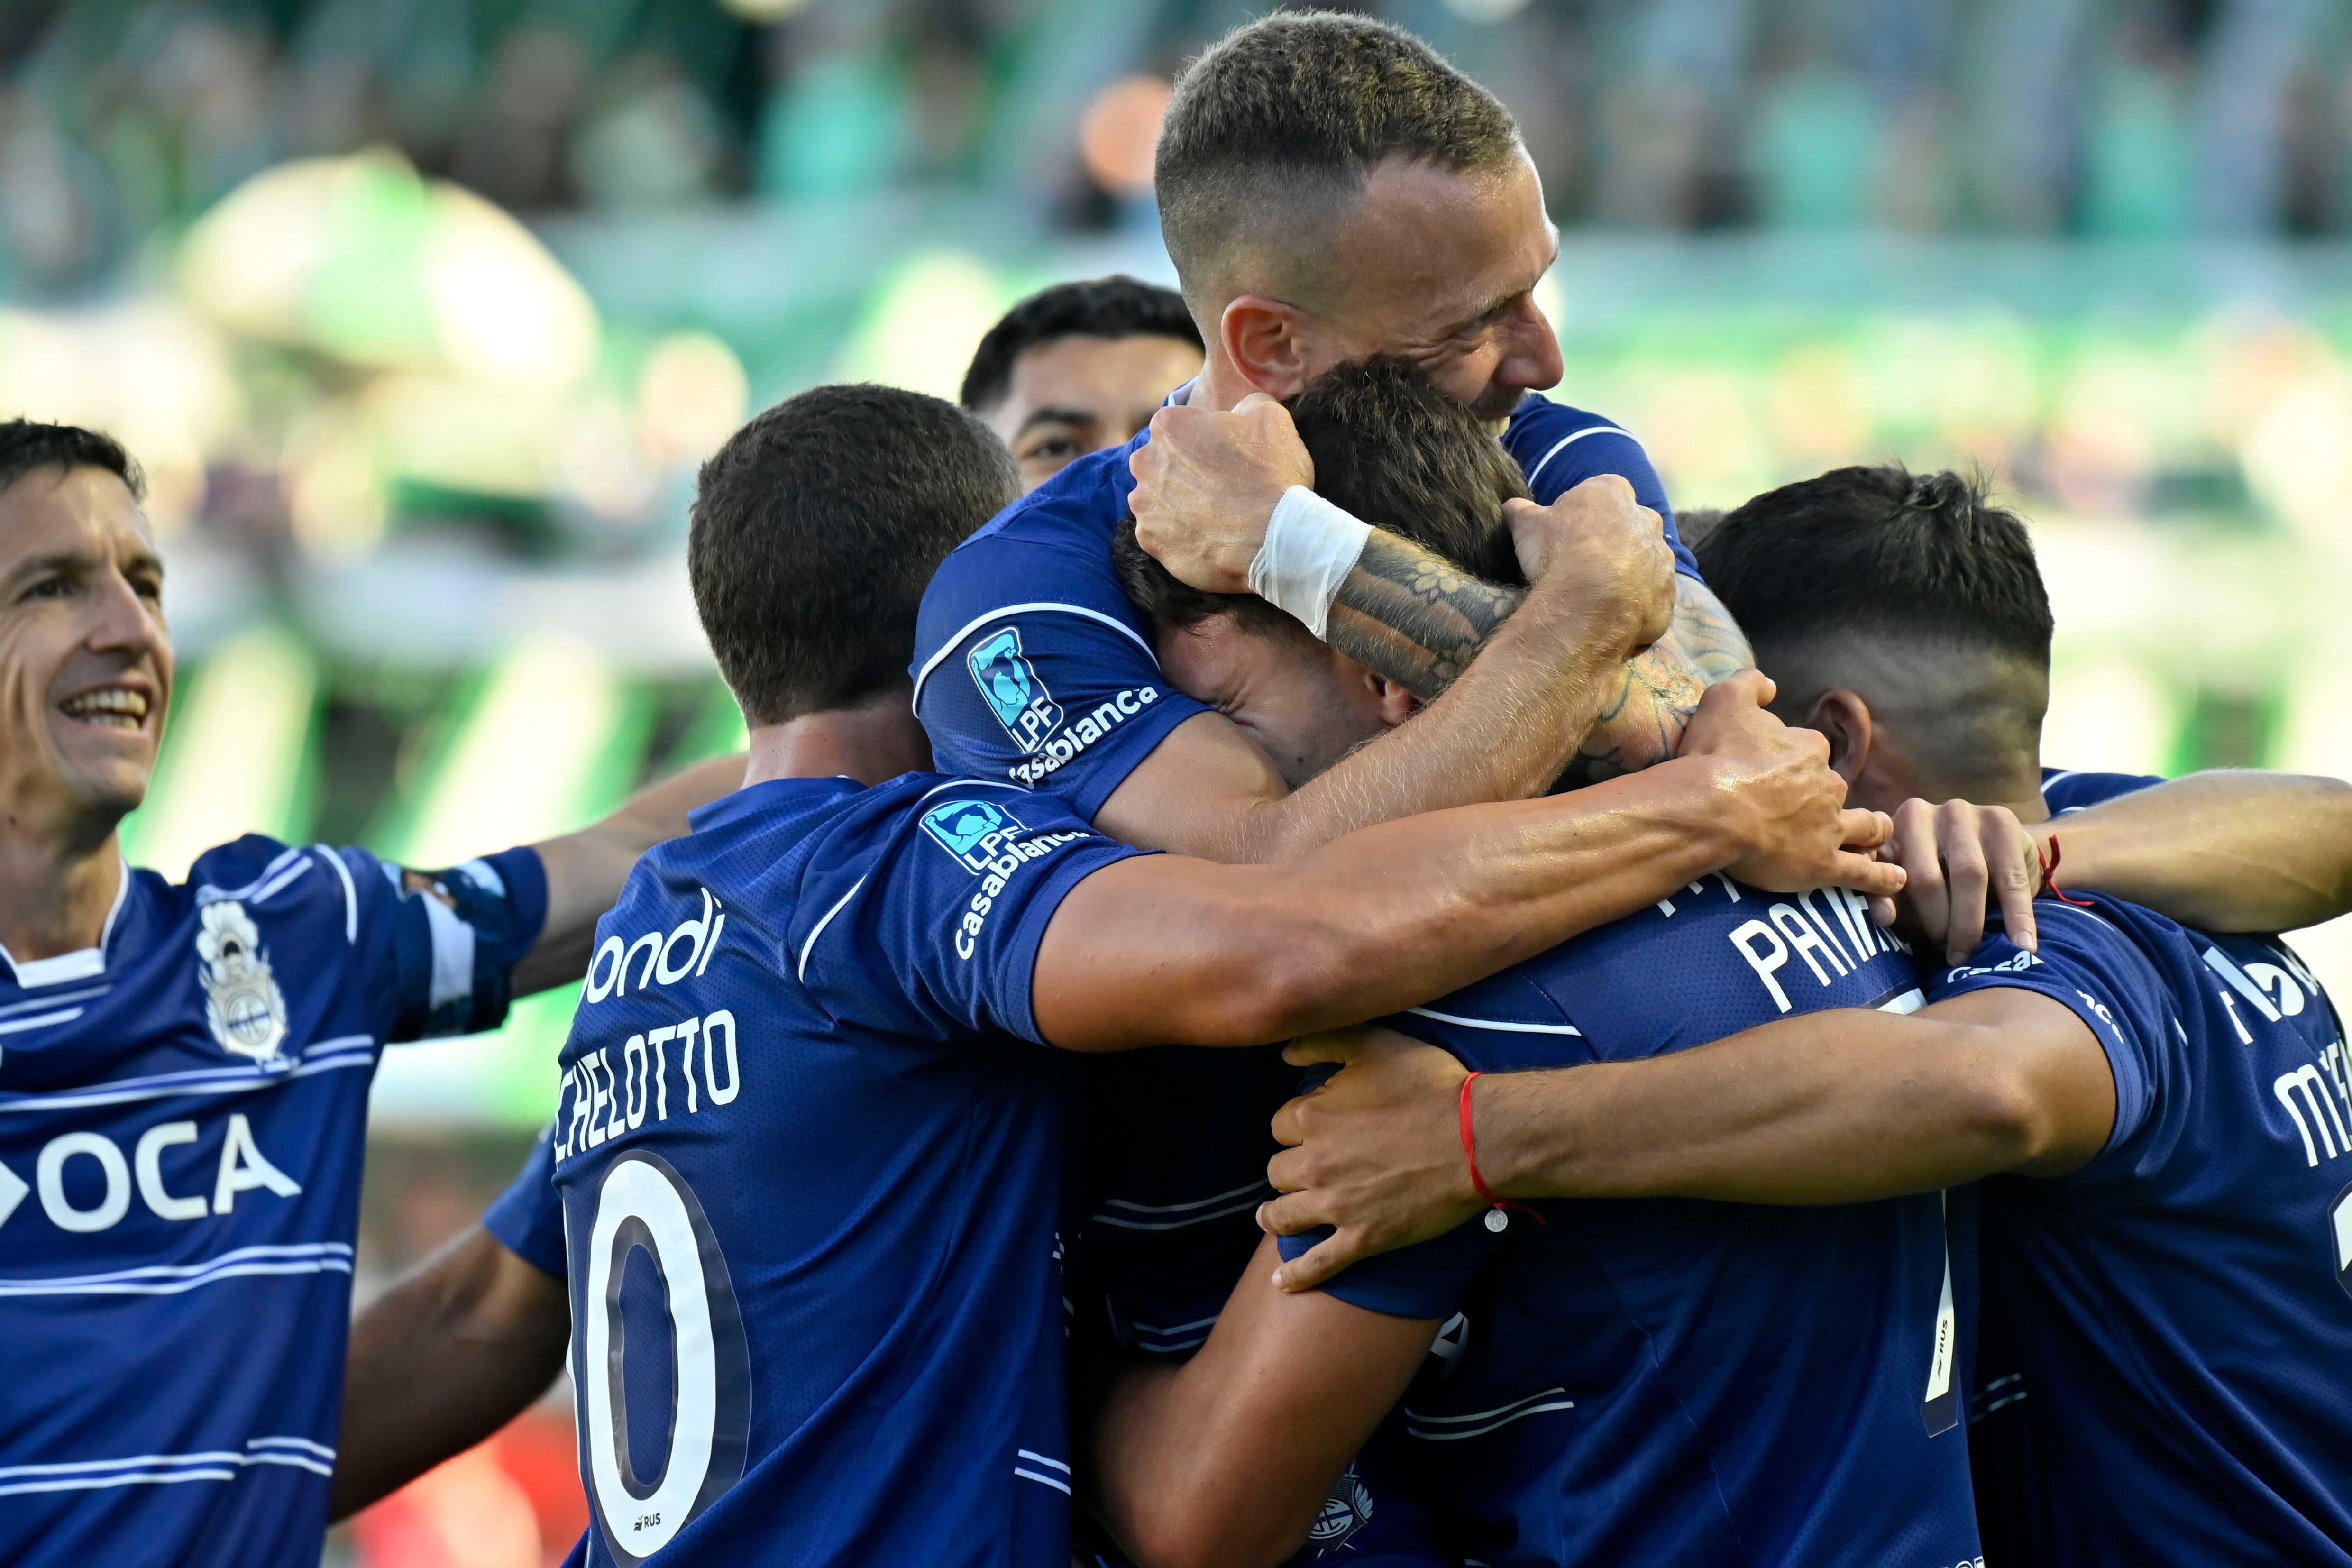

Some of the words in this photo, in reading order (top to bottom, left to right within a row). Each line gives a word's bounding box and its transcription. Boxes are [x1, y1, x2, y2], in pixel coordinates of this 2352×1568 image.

[1012, 696, 1053, 752] LPF
[963, 825, 1023, 871] LPF
[576, 887, 725, 1004] ondi
[554, 1009, 740, 1164] CHELOTTO
[36, 1114, 302, 1233] OCA
[564, 1159, 716, 1558] 0
[644, 1512, 661, 1529] RUS
